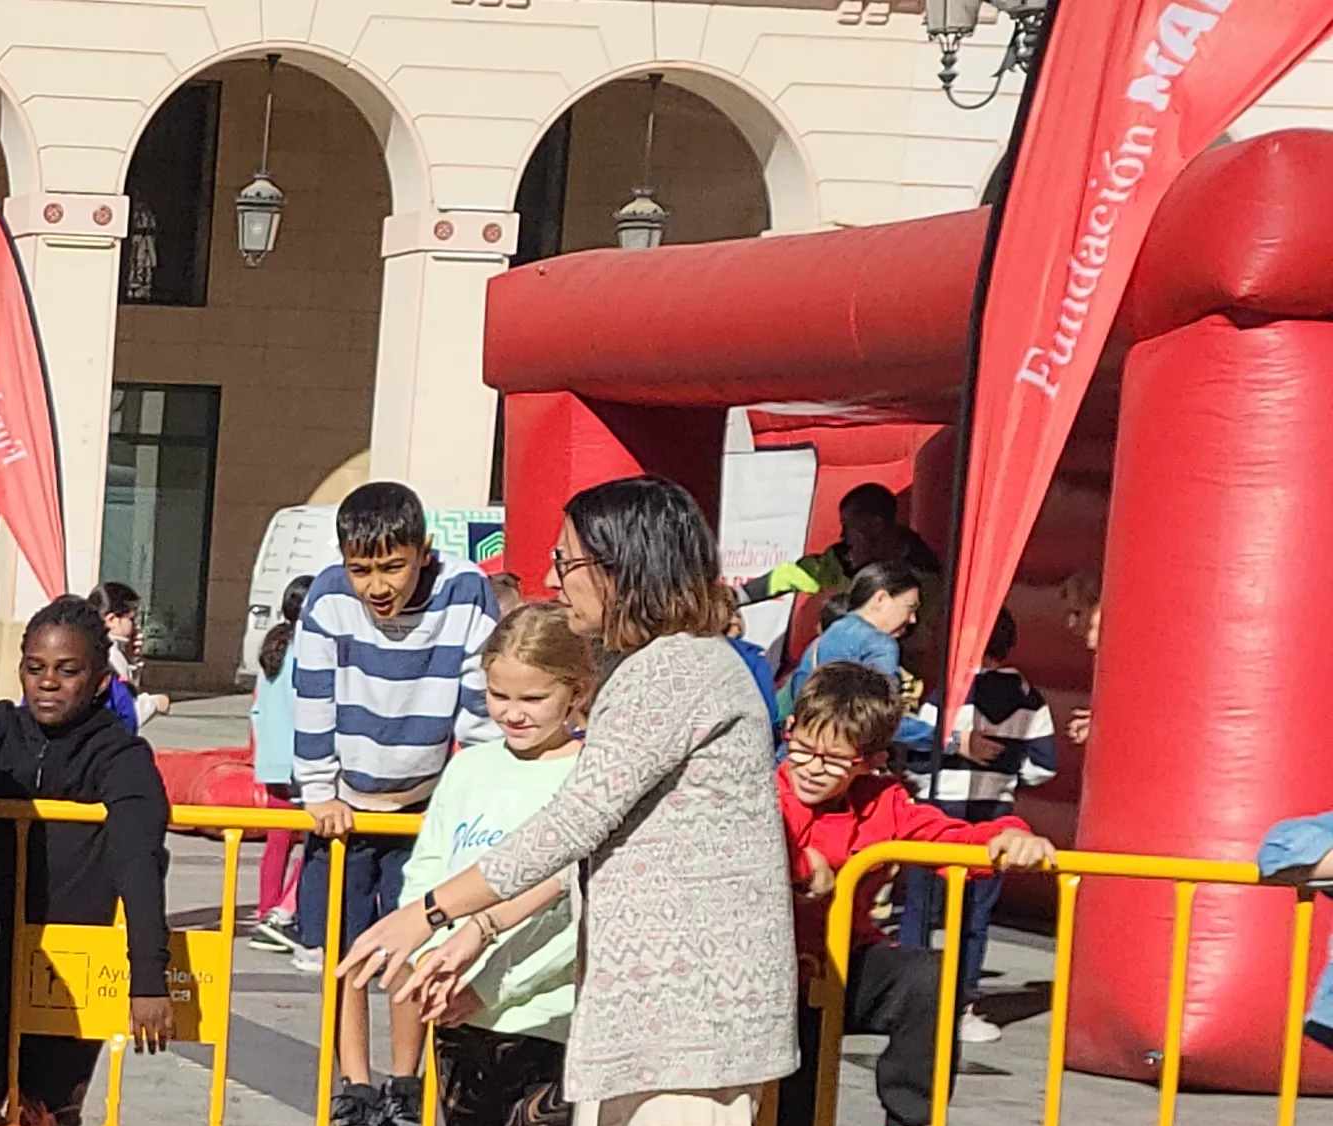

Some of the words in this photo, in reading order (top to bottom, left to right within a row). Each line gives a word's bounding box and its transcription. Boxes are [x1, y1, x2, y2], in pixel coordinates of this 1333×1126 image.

[1014, 126, 1158, 400] Fundación
[1123, 0, 1233, 112] MA
[452, 812, 504, 856] Phoe
